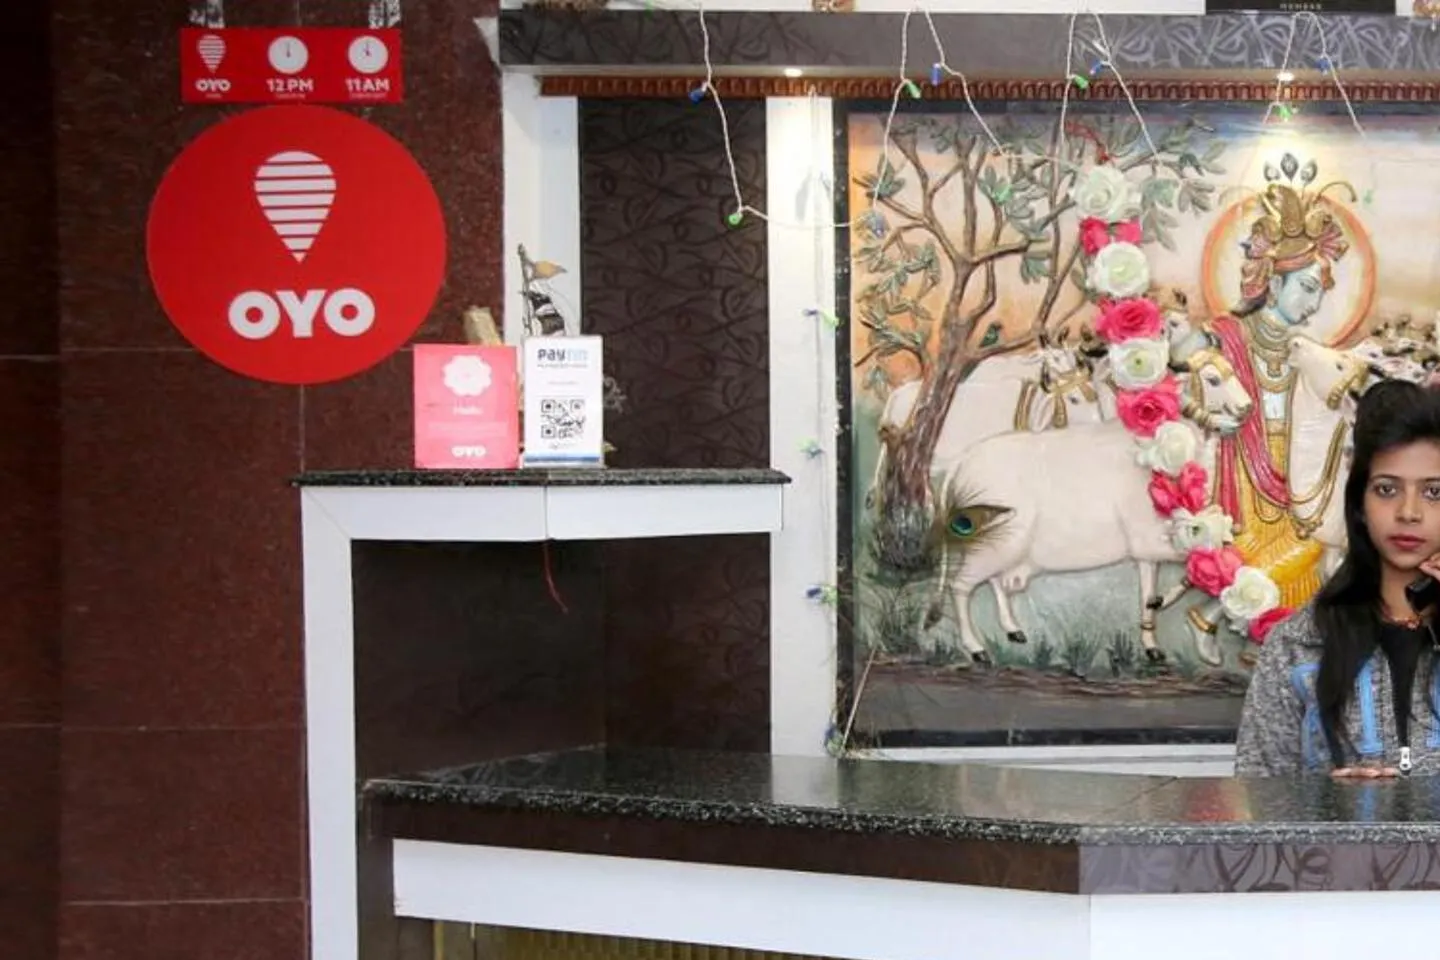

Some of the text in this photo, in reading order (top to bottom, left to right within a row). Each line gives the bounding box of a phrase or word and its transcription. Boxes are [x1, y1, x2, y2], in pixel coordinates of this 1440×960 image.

[195, 79, 231, 92] OYO
[228, 287, 376, 340] OYO
[451, 445, 487, 458] OYO
